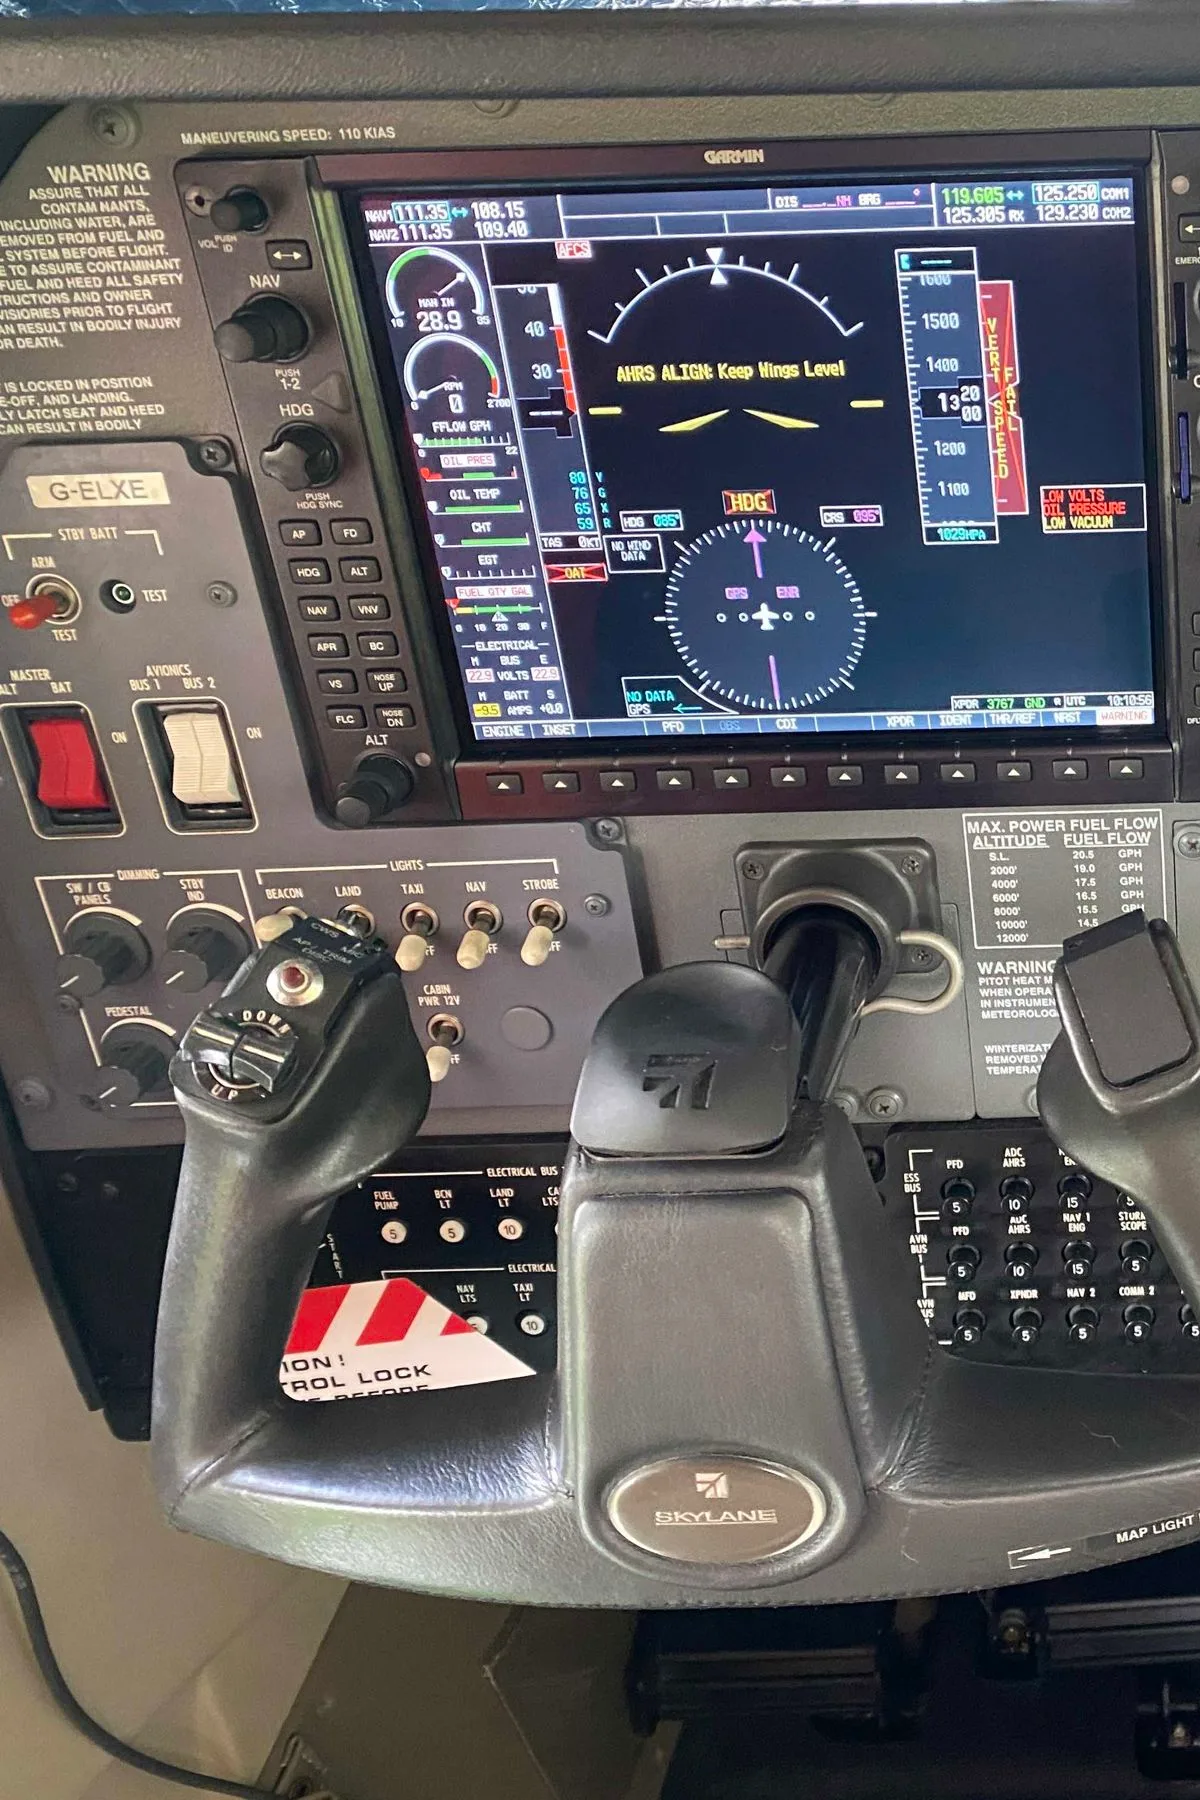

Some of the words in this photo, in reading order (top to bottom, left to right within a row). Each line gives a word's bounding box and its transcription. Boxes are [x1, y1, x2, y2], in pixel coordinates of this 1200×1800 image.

[181, 131, 280, 145] MANEUVERING
[283, 130, 332, 142] SPEED:
[339, 128, 360, 140] 110
[364, 127, 395, 139] KIAS
[704, 150, 764, 164] GARMIN
[48, 162, 151, 184] WARNING
[29, 187, 83, 200] ASSURE
[942, 188, 1004, 205] 119.605
[395, 204, 448, 220] 111.35
[472, 202, 524, 219] 108.15
[74, 216, 126, 229] WATER,
[129, 214, 155, 227] ARE
[58, 232, 95, 244] FROM
[98, 231, 129, 242] FUEL
[400, 225, 452, 240] 111.35
[474, 222, 528, 237] 109.40
[7, 248, 58, 261] SYSTEM
[62, 246, 116, 258] BEFORE
[119, 244, 168, 256] FLIGHT.
[30, 262, 84, 275] ASSURE
[87, 258, 181, 272] CONTAMINANT
[250, 275, 280, 288] NAV
[64, 305, 100, 317] PRIOR
[126, 302, 172, 314] FLIGHT
[417, 312, 462, 331] 28.9
[922, 314, 959, 329] 1500
[524, 322, 544, 336] 40
[16, 336, 62, 349] DEATH.
[532, 364, 551, 378] 30
[617, 366, 654, 382] AHRS
[661, 364, 713, 380] ALIGN:
[718, 364, 754, 380] Keep
[759, 362, 799, 377] Wings
[804, 360, 845, 377] Level
[926, 358, 958, 372] 1400
[20, 380, 72, 391] LOCKED
[94, 377, 152, 389] POSITION
[281, 378, 301, 390] 1-2
[20, 408, 58, 420] LATCH
[62, 406, 95, 418] SEAT
[131, 404, 164, 415] HEED
[280, 404, 313, 416] HDG
[935, 441, 966, 456] 1200
[49, 479, 146, 500] G-ELXE
[450, 489, 471, 499] OIL
[476, 489, 500, 499] TEMP
[938, 482, 969, 496] 1100
[1043, 490, 1064, 503] LOW
[1069, 490, 1105, 502] VOLTS
[1069, 502, 1126, 515] PRESSURE
[472, 522, 491, 532] CHT
[624, 517, 644, 528] HDG
[1045, 517, 1066, 529] LOW
[1071, 516, 1113, 528] VACUUM
[58, 528, 84, 540] STBY
[90, 527, 117, 539] BATT
[292, 529, 305, 539] AP
[541, 537, 563, 547] TAS
[478, 555, 497, 565] EGT
[297, 567, 320, 578] HDG
[351, 566, 367, 576] ALT
[142, 590, 167, 601] TEST
[459, 588, 483, 597] FUEL
[358, 605, 378, 614] VNV
[317, 641, 337, 652] APR
[476, 641, 537, 651] ELECTRICAL
[10, 669, 51, 680] MASTER
[146, 664, 191, 676] AVIONICS
[497, 670, 529, 681] VOLTS
[52, 682, 71, 693] BAT
[129, 680, 149, 690] BUS
[183, 678, 204, 689] BUS
[626, 691, 642, 701] NO
[646, 691, 674, 701] DATA
[987, 699, 1014, 709] 3767
[247, 727, 261, 739] ON
[483, 725, 524, 736] ENGINE
[112, 732, 126, 743] ON
[365, 734, 388, 746] ALT
[967, 820, 1005, 834] MAX.
[1009, 819, 1065, 833] POWER
[1069, 818, 1111, 831] FUEL
[1114, 817, 1158, 830] FLOW
[973, 834, 1046, 848] ALTITUDE
[1064, 833, 1105, 845] FUEL
[1108, 832, 1151, 845] FLOW
[390, 860, 424, 872] LIGHTS
[1074, 864, 1095, 873] 19.0
[1119, 863, 1142, 872] GPH
[466, 882, 486, 893] NAV
[522, 878, 559, 891] STROBE
[335, 886, 361, 897] LAND
[979, 976, 1010, 985] PITOT
[1013, 976, 1042, 985] HEAT
[487, 1168, 536, 1177] ELECTRICAL
[541, 1166, 558, 1175] BUS
[375, 1201, 399, 1210] PUMP
[358, 1365, 432, 1383] LOCK
[655, 1509, 777, 1526] SKYLANE
[1115, 1526, 1148, 1544] MAP
[1151, 1517, 1194, 1536] LIGHT
